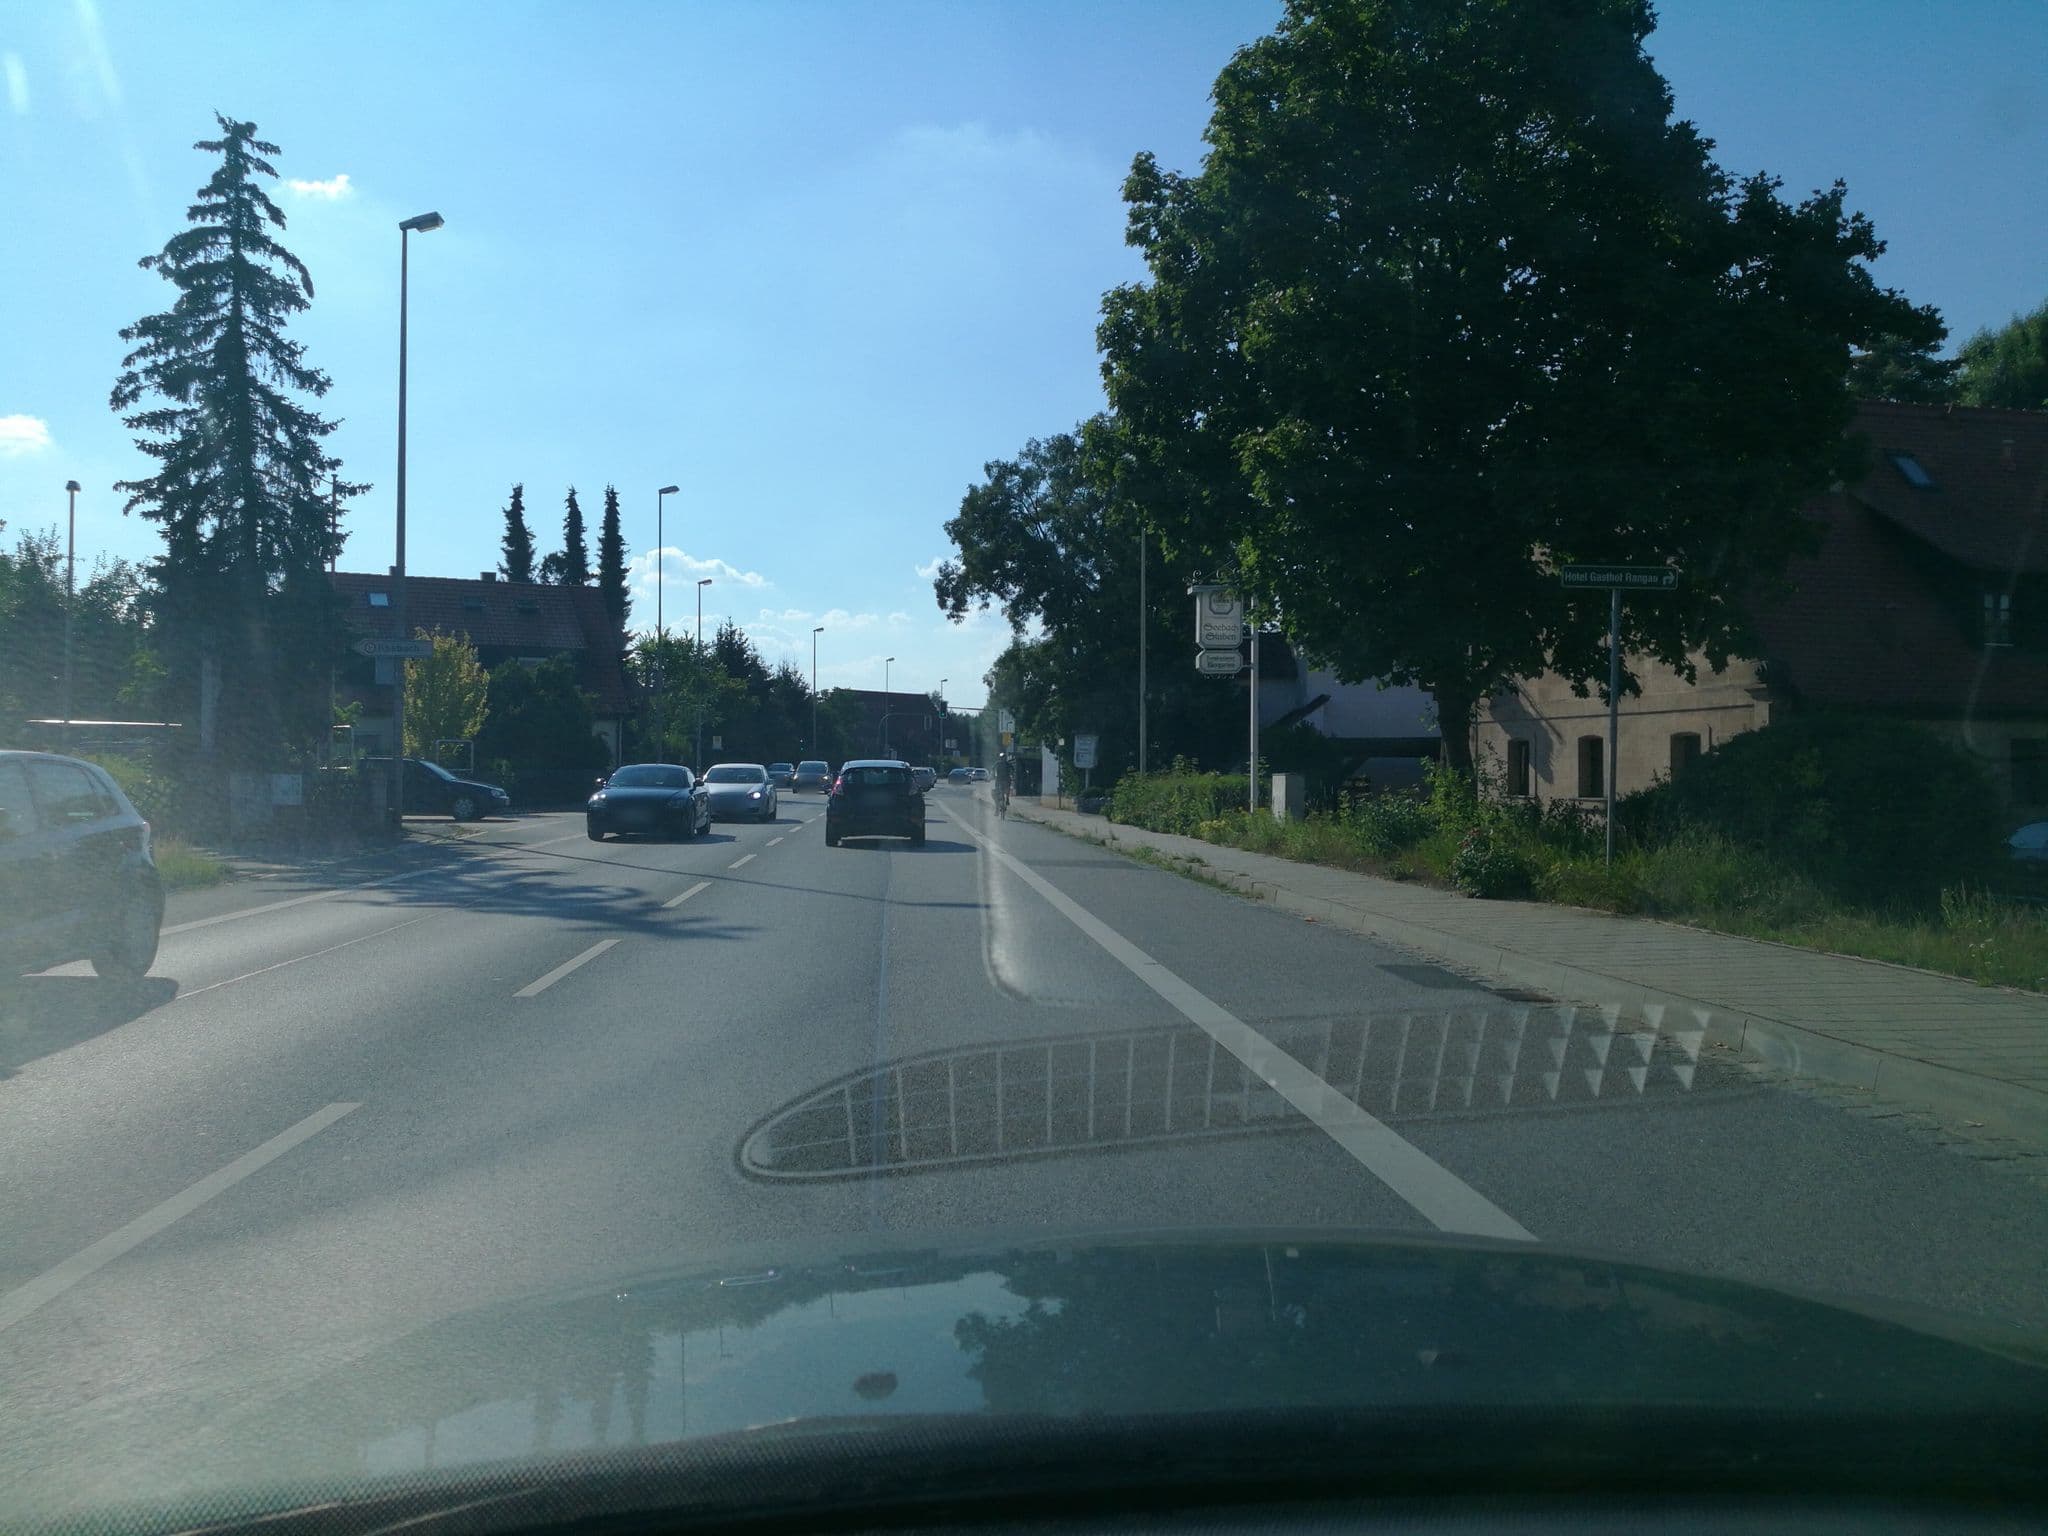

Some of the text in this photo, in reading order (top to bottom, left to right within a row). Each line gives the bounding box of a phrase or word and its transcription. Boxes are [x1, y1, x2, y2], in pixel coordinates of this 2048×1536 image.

[1564, 571, 1658, 585] Hotel Gasthof Rangau
